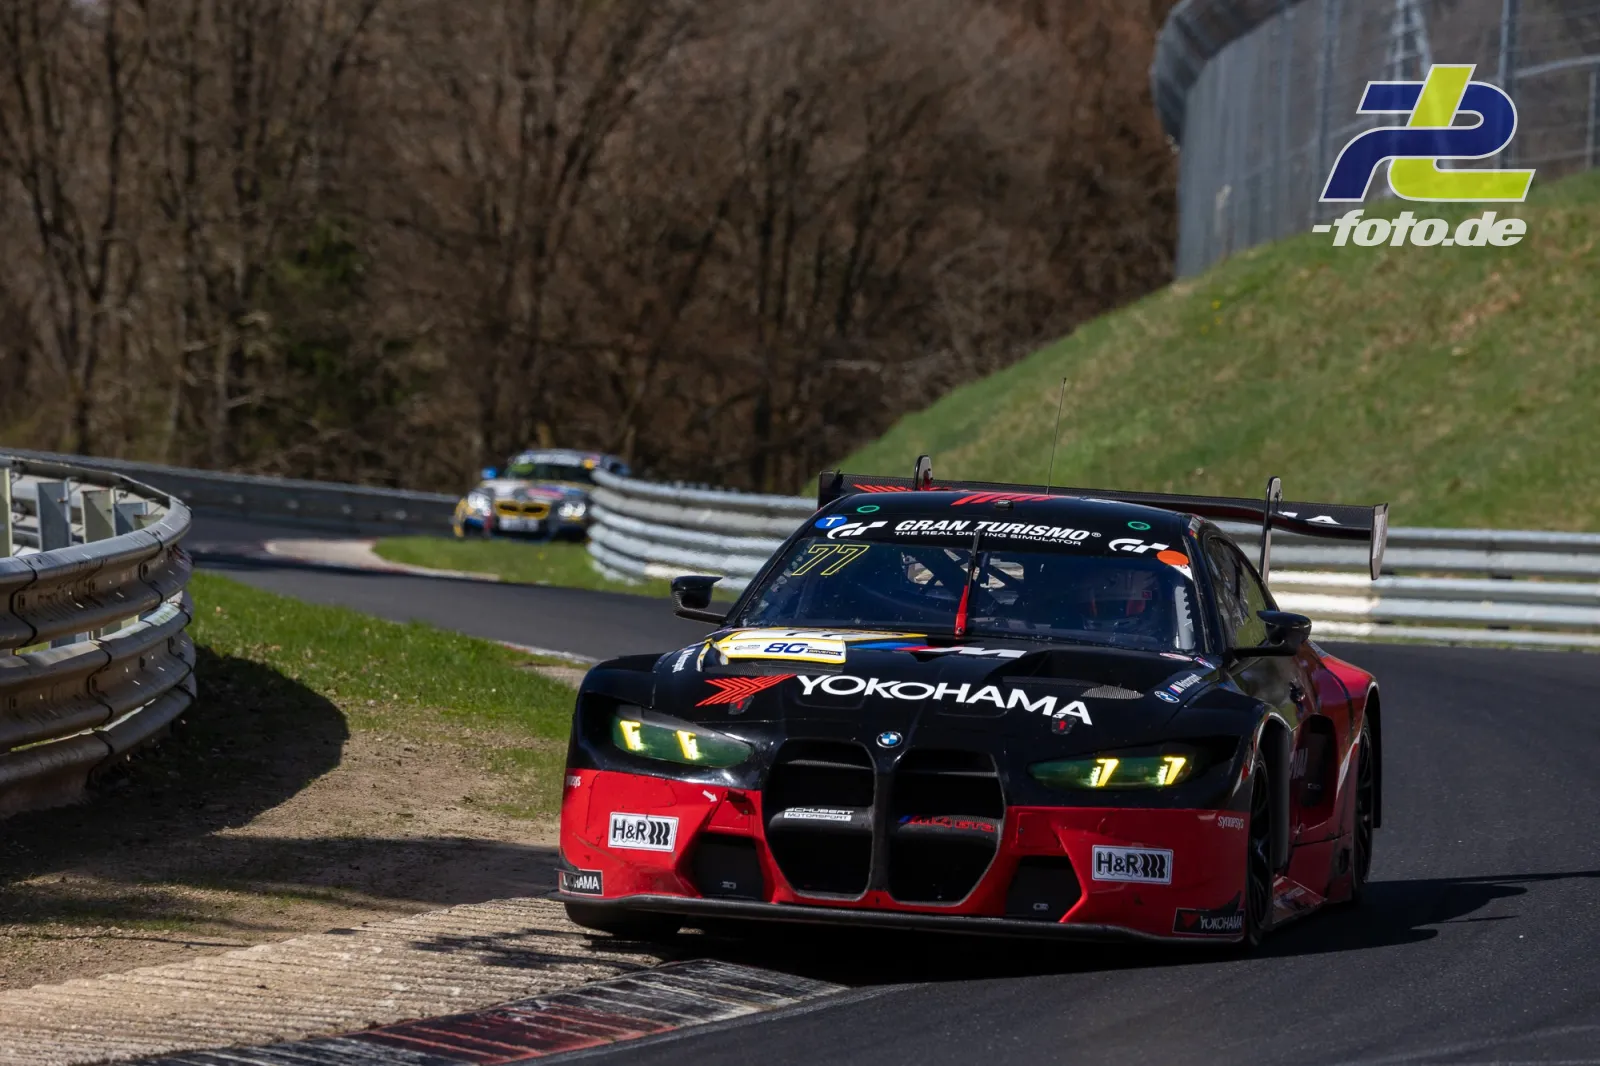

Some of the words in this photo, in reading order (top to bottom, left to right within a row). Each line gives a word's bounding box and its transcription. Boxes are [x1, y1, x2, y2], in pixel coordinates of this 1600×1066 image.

[895, 520, 971, 531] GRAN
[1010, 534, 1082, 546] SIMULATOR
[792, 544, 870, 576] 77
[797, 675, 1093, 725] YOKOHAMA
[612, 818, 647, 842] H&R
[1096, 851, 1140, 875] H&R
